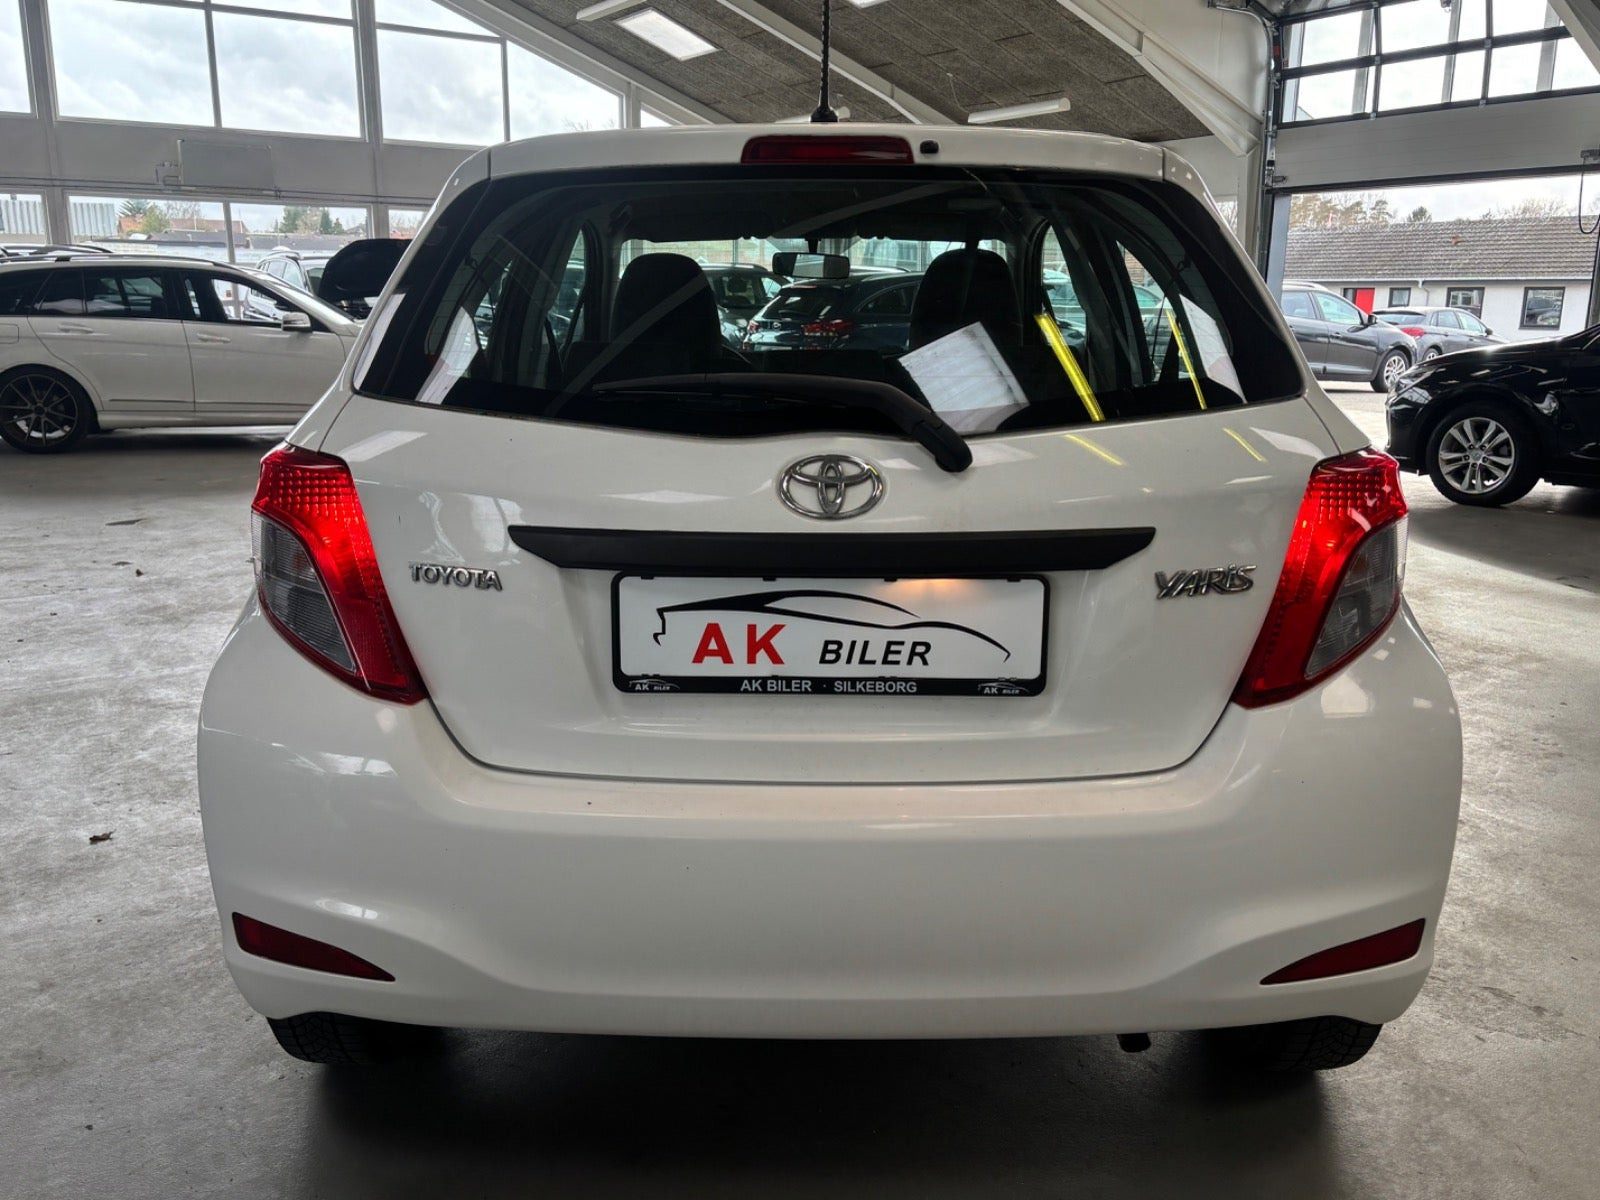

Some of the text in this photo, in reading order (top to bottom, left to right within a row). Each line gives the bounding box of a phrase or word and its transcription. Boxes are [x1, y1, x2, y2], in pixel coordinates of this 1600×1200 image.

[408, 563, 503, 591] TOYOTA
[818, 639, 932, 666] BILER
[740, 680, 918, 692] AK BILER SILKEBORG
